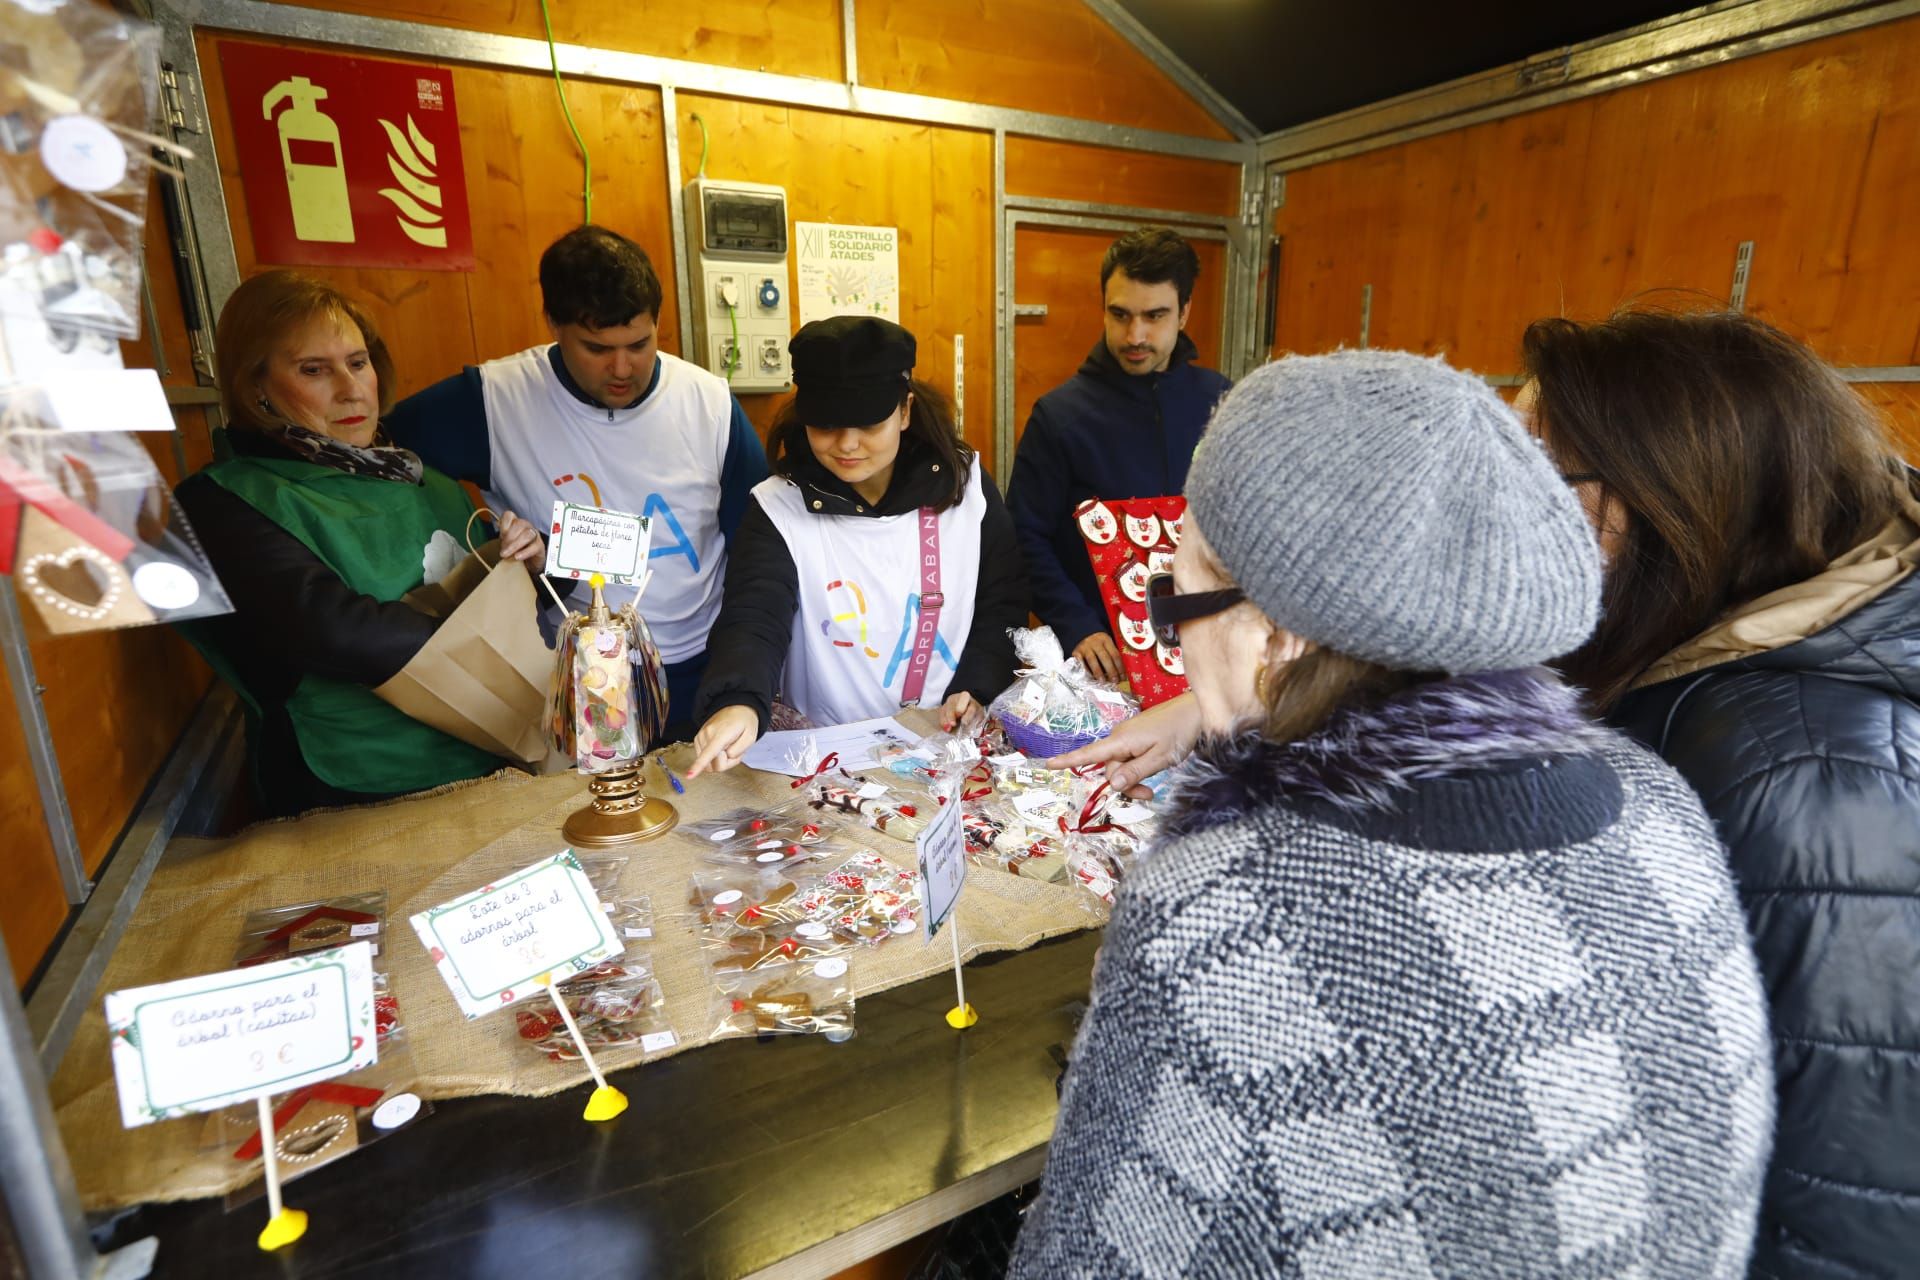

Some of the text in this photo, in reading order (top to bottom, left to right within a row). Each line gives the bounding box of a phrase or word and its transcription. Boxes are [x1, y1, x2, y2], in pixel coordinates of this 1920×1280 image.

[801, 227, 823, 258] XIII
[828, 229, 893, 242] RASTRILLO
[829, 239, 893, 252] SOLIDARIO
[830, 250, 875, 261] ATADES
[570, 510, 636, 531] Marcapáginas con
[571, 525, 632, 542] pétalos de flores
[591, 541, 612, 550] secas
[913, 504, 938, 677] JORDI LABAN
[469, 881, 531, 919] Lote de 3
[460, 888, 563, 944] adornos para el
[252, 993, 297, 1014] para
[302, 983, 320, 999] el
